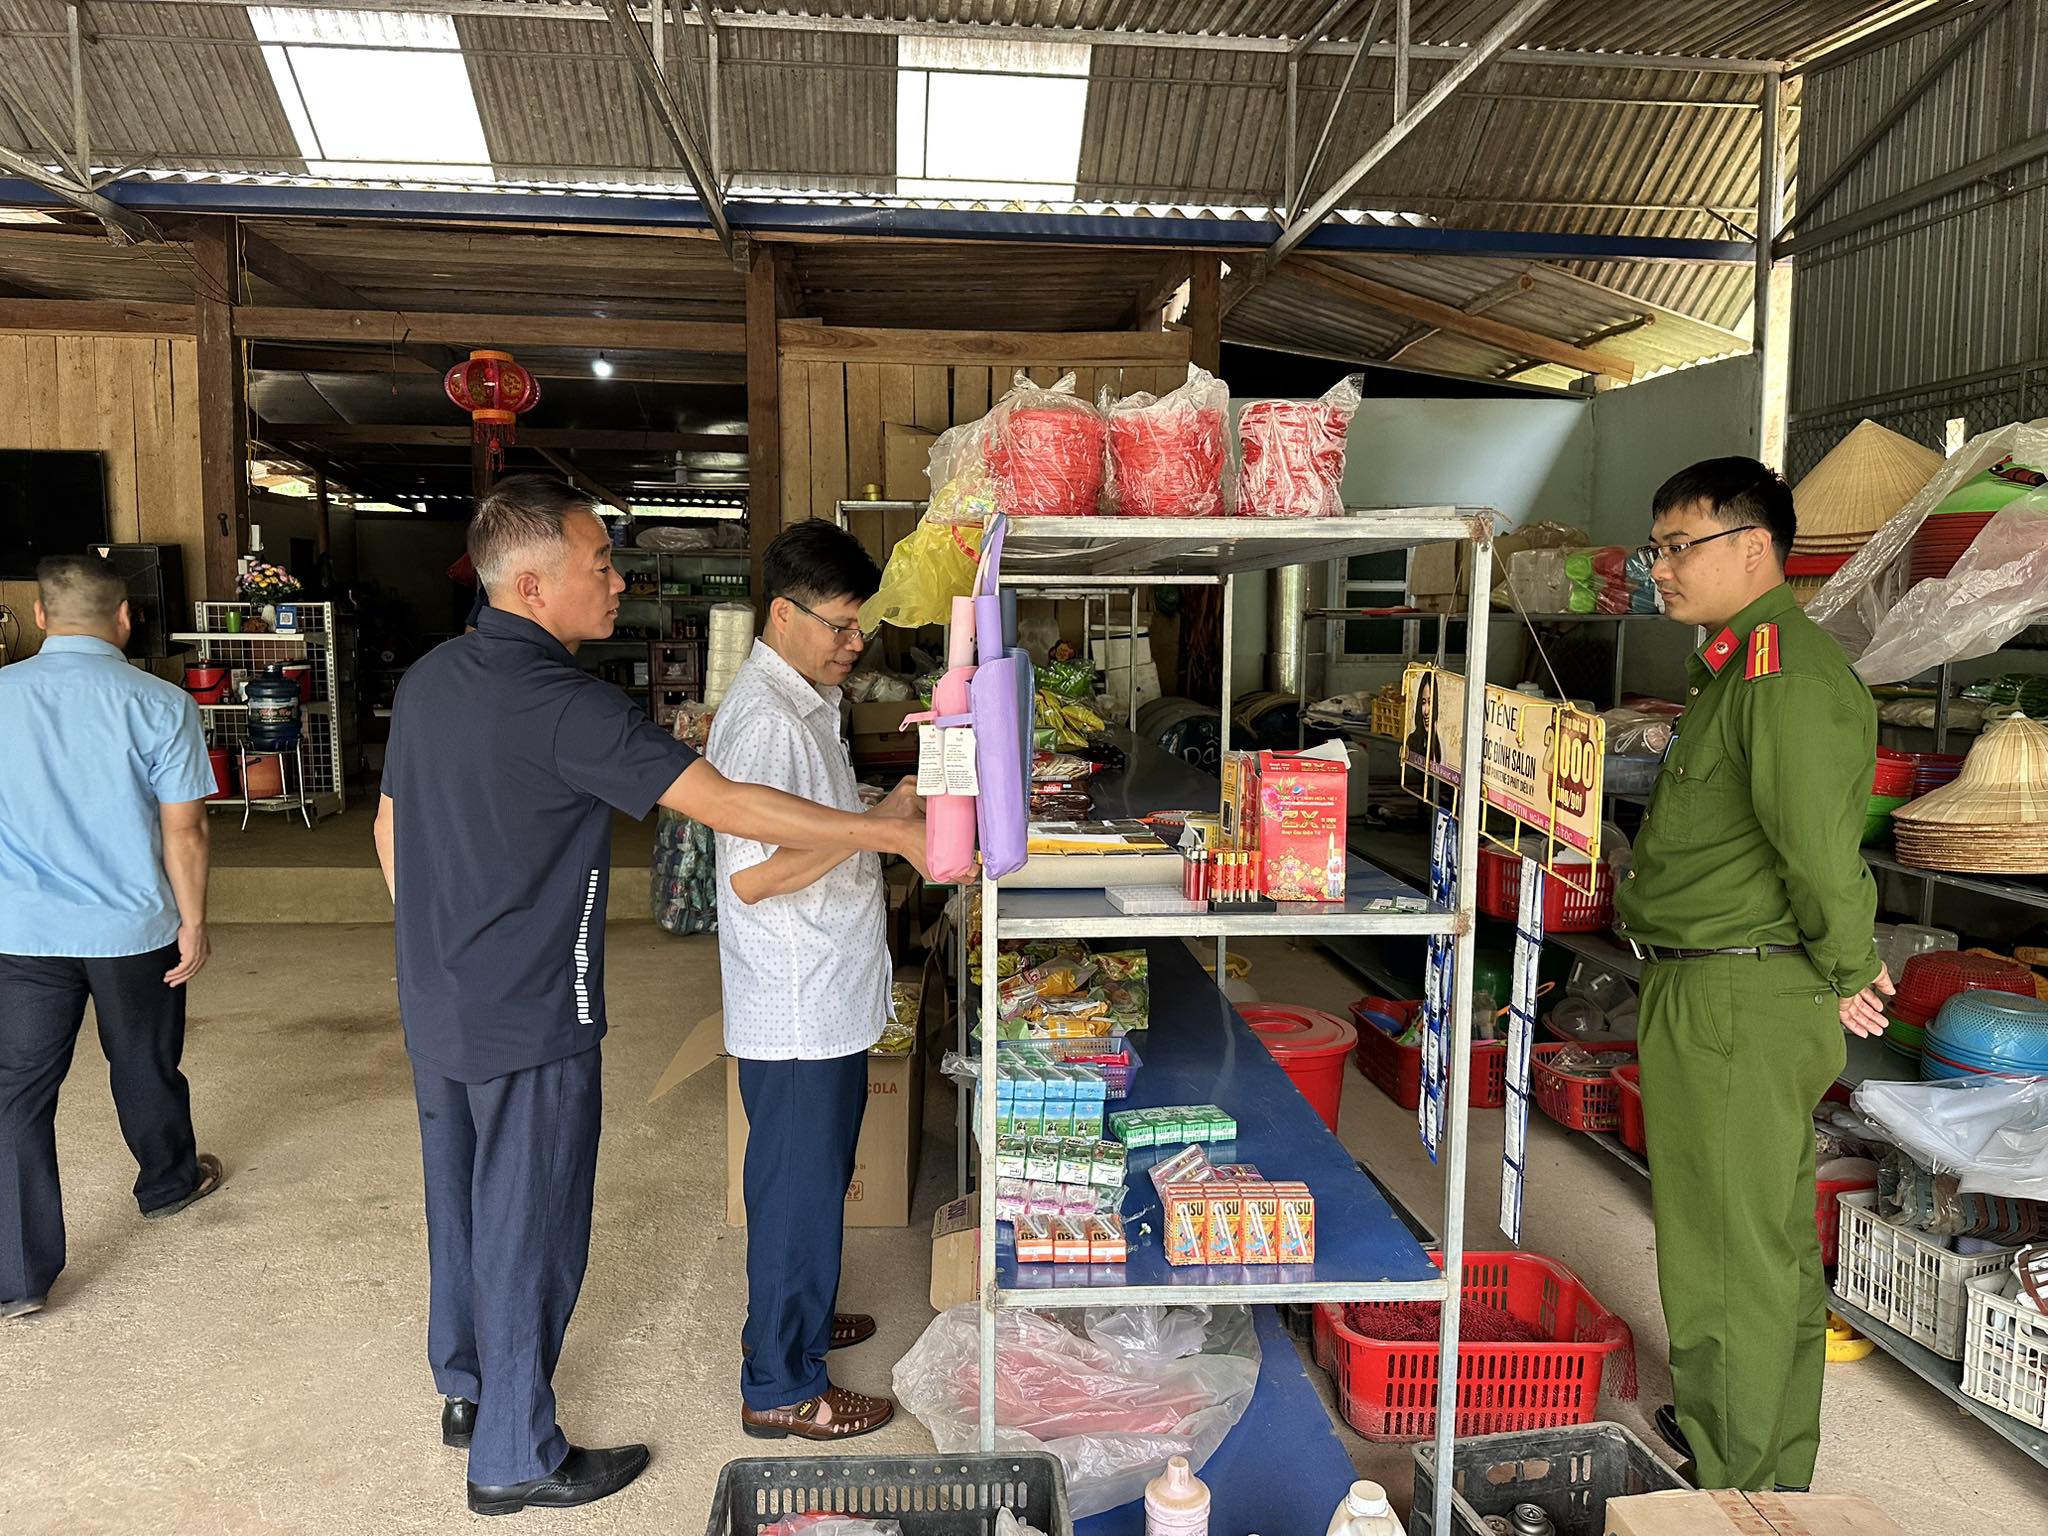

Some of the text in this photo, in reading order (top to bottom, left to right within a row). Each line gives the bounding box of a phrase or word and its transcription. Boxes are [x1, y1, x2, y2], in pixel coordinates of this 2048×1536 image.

[1494, 736, 1511, 769] ĐỈNH
[1511, 748, 1537, 780] SALON
[1507, 799, 1528, 820] BIOTIN
